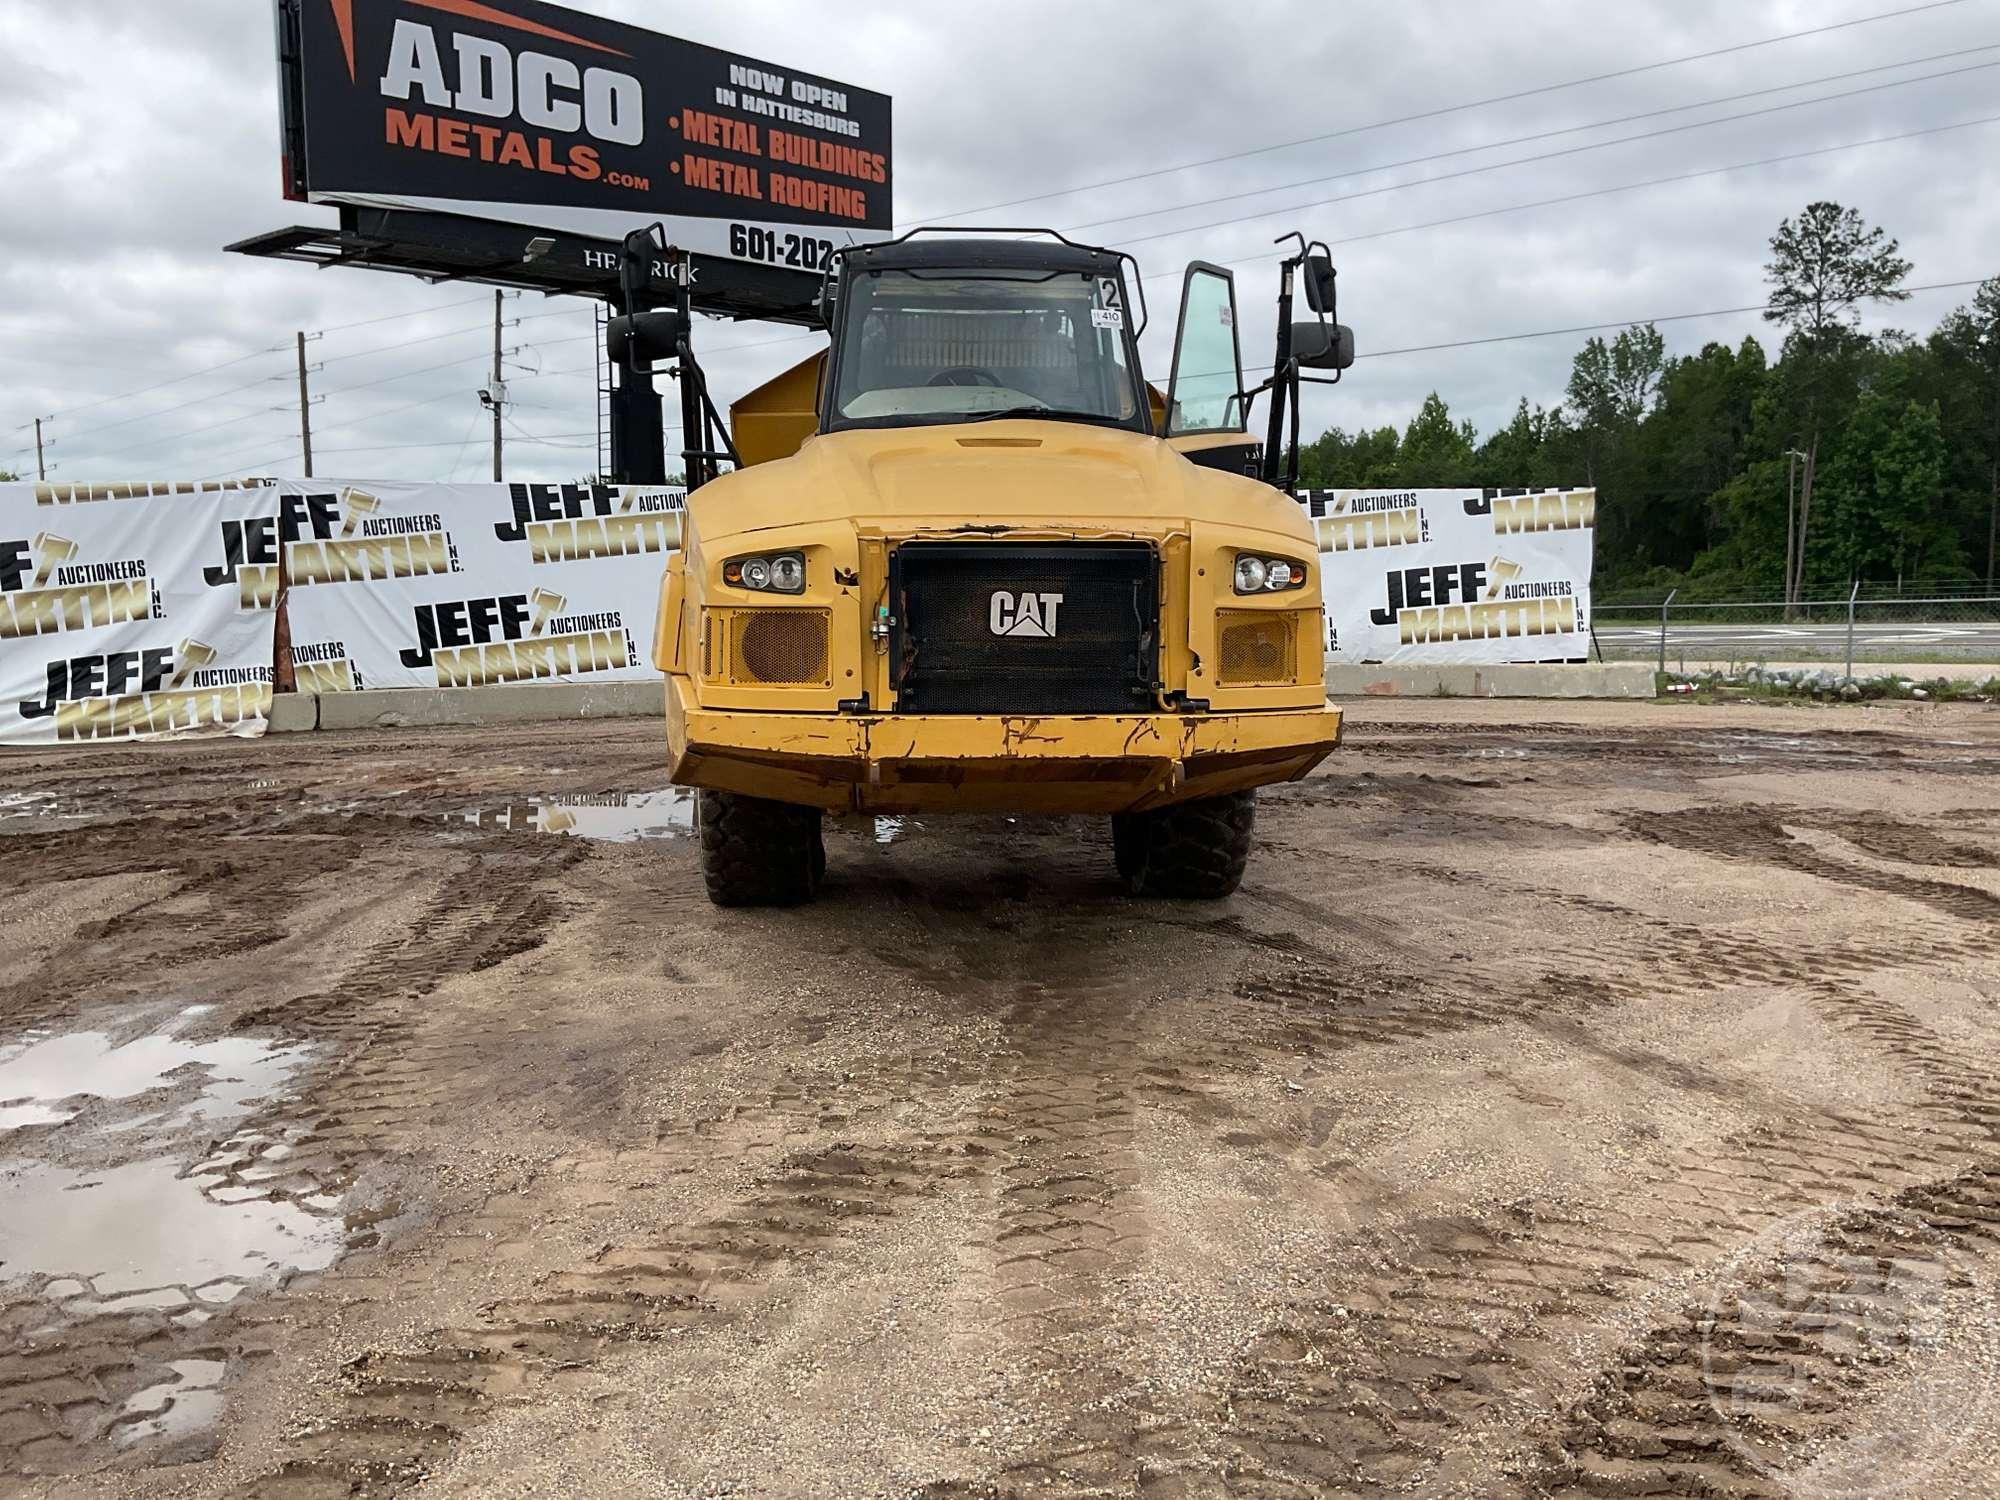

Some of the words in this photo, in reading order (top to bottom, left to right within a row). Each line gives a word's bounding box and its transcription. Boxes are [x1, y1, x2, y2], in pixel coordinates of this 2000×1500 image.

[380, 18, 644, 147] ADCO
[730, 64, 785, 97] NOW
[791, 81, 848, 113] OPEN
[715, 87, 737, 108] IN
[742, 93, 860, 138] HATTIESBURG
[682, 108, 762, 156] METAL
[768, 129, 886, 184] BUILDINGS
[683, 154, 763, 200] METAL
[769, 173, 866, 221] ROOFING
[1102, 280, 1121, 308] 2
[363, 514, 441, 537] AUCTIONEERS
[1351, 492, 1417, 514] AUCTIONEERS
[57, 559, 147, 587] AUCTIONEERS
[1370, 562, 1487, 626] JEFF
[1504, 581, 1572, 601] AUCTIONEERS
[399, 594, 530, 669] JEFF
[550, 611, 622, 635] AUCTIONEERS
[990, 590, 1064, 637] CAT
[1399, 597, 1575, 646] MARTIN
[18, 646, 174, 720] JEFF
[192, 667, 274, 689] AUCTIONEERS
[433, 629, 627, 688] MARTIN
[56, 683, 272, 742] MARTIN
